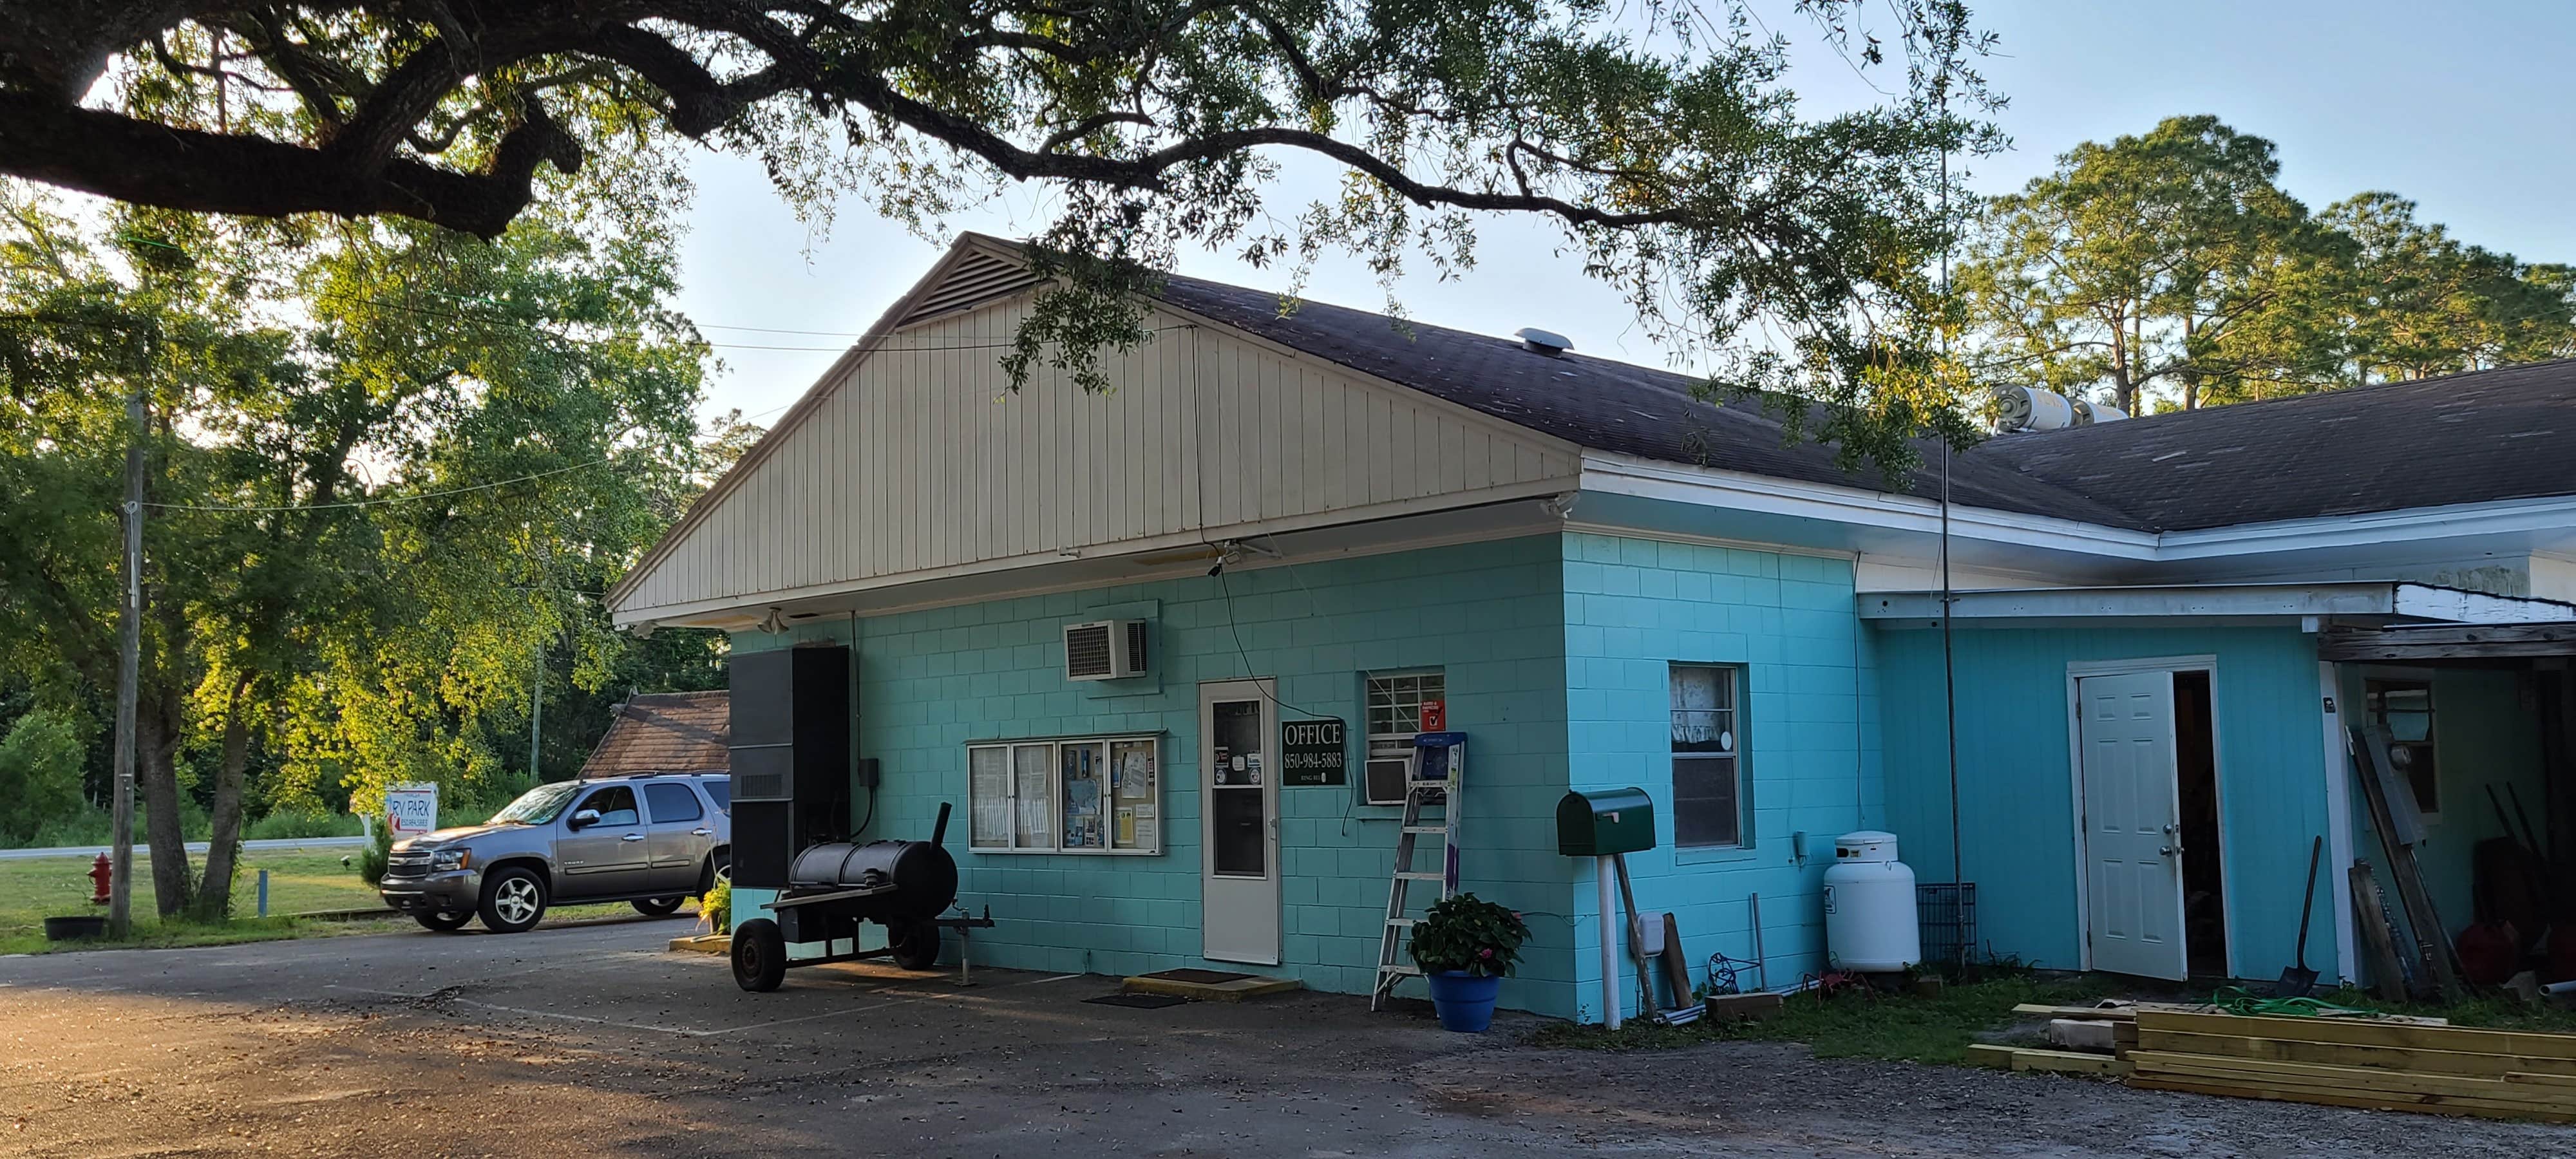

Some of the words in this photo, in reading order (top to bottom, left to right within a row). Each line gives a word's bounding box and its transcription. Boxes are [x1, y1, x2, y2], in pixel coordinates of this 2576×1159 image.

[1285, 724, 1341, 746] OFFICE
[1284, 752, 1342, 769] 850-984-5883
[393, 800, 405, 816] RV
[407, 800, 430, 817] PARK
